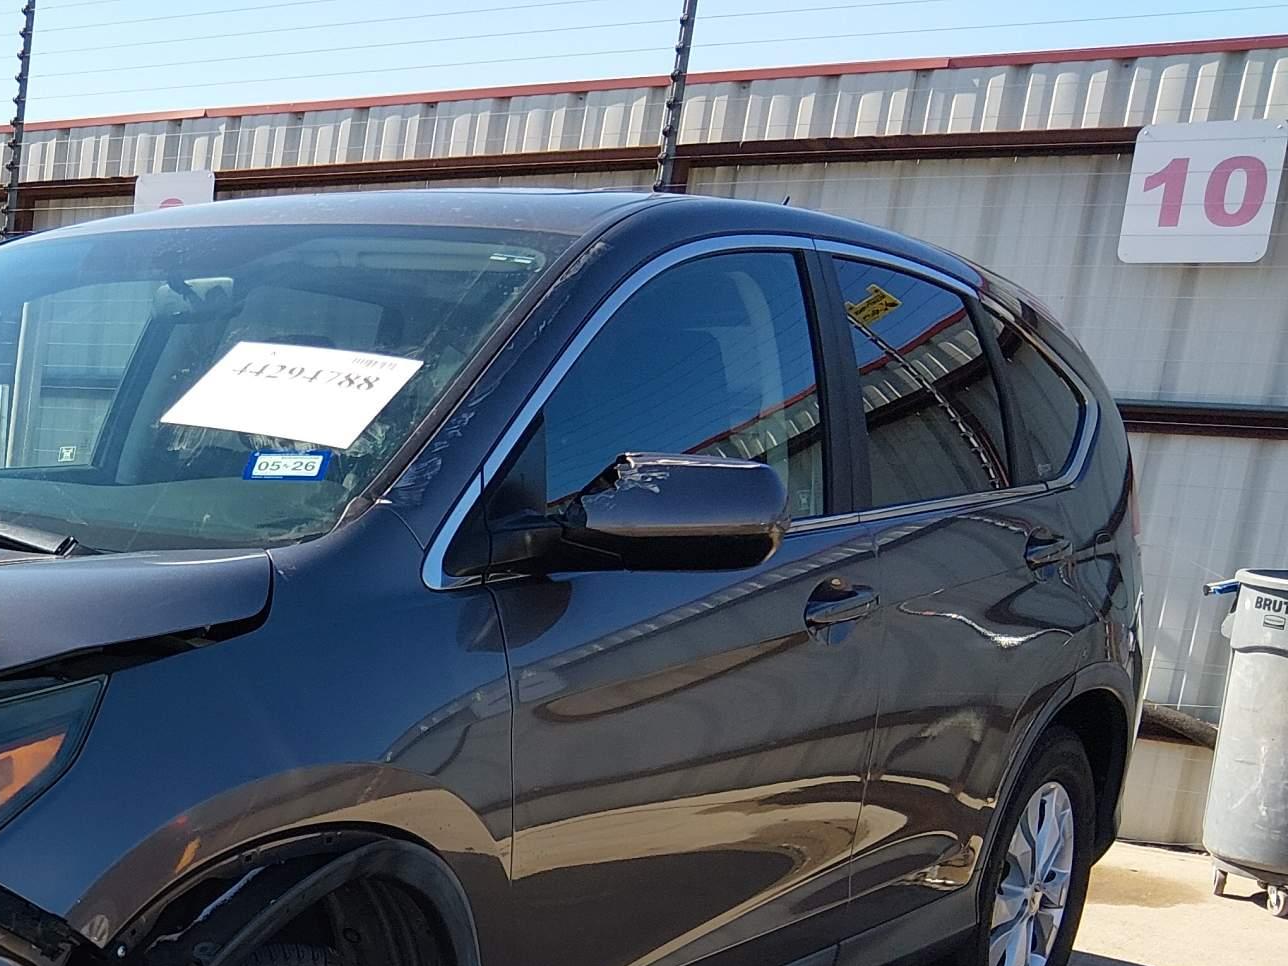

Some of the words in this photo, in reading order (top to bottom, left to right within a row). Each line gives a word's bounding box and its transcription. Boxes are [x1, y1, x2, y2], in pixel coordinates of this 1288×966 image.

[1143, 155, 1268, 228] 10
[232, 361, 381, 391] 44294788
[257, 460, 282, 472] 05
[291, 460, 317, 472] 26
